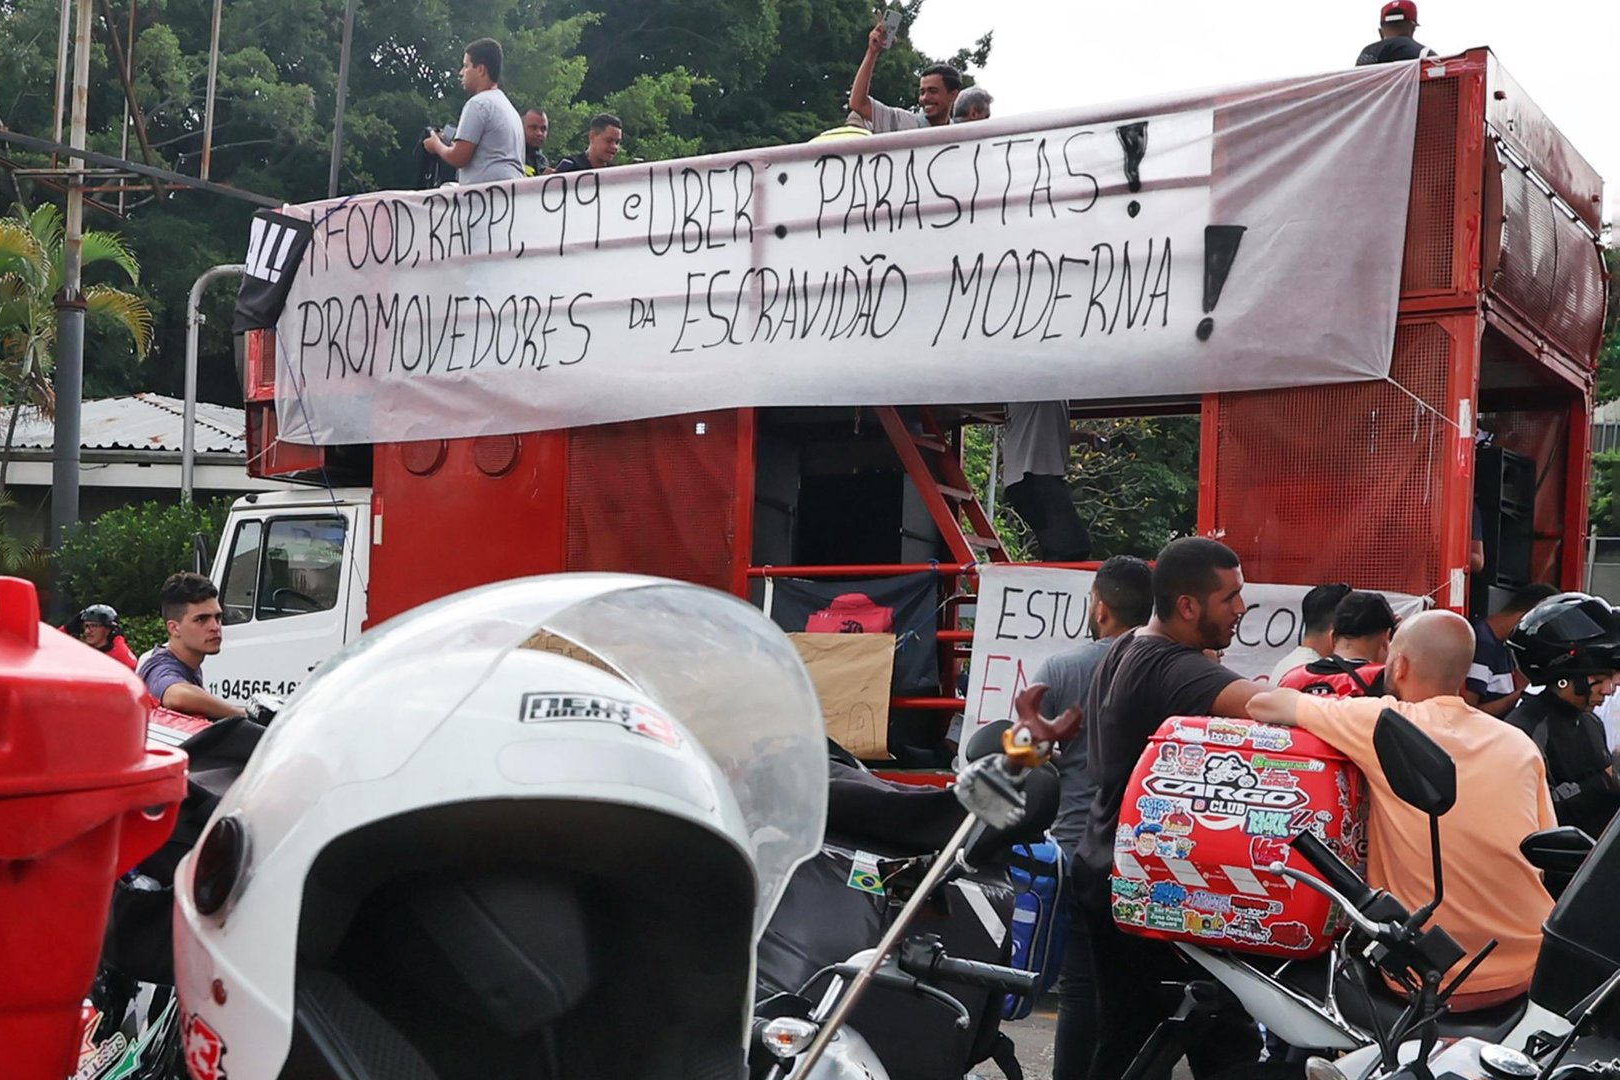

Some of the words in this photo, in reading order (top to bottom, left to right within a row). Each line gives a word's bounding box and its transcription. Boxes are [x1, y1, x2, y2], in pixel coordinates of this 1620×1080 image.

[423, 183, 526, 259] RAPPI,
[541, 172, 601, 256] 99
[297, 291, 594, 387] PROMOVEDORES
[628, 296, 657, 330] DA
[670, 253, 909, 353] ESCRAVIDÃO
[995, 586, 1091, 640] ESTU
[208, 682, 218, 695] 11
[221, 679, 301, 700] 94565-16
[1150, 779, 1299, 807] CARGO
[1208, 799, 1247, 816] CLUB
